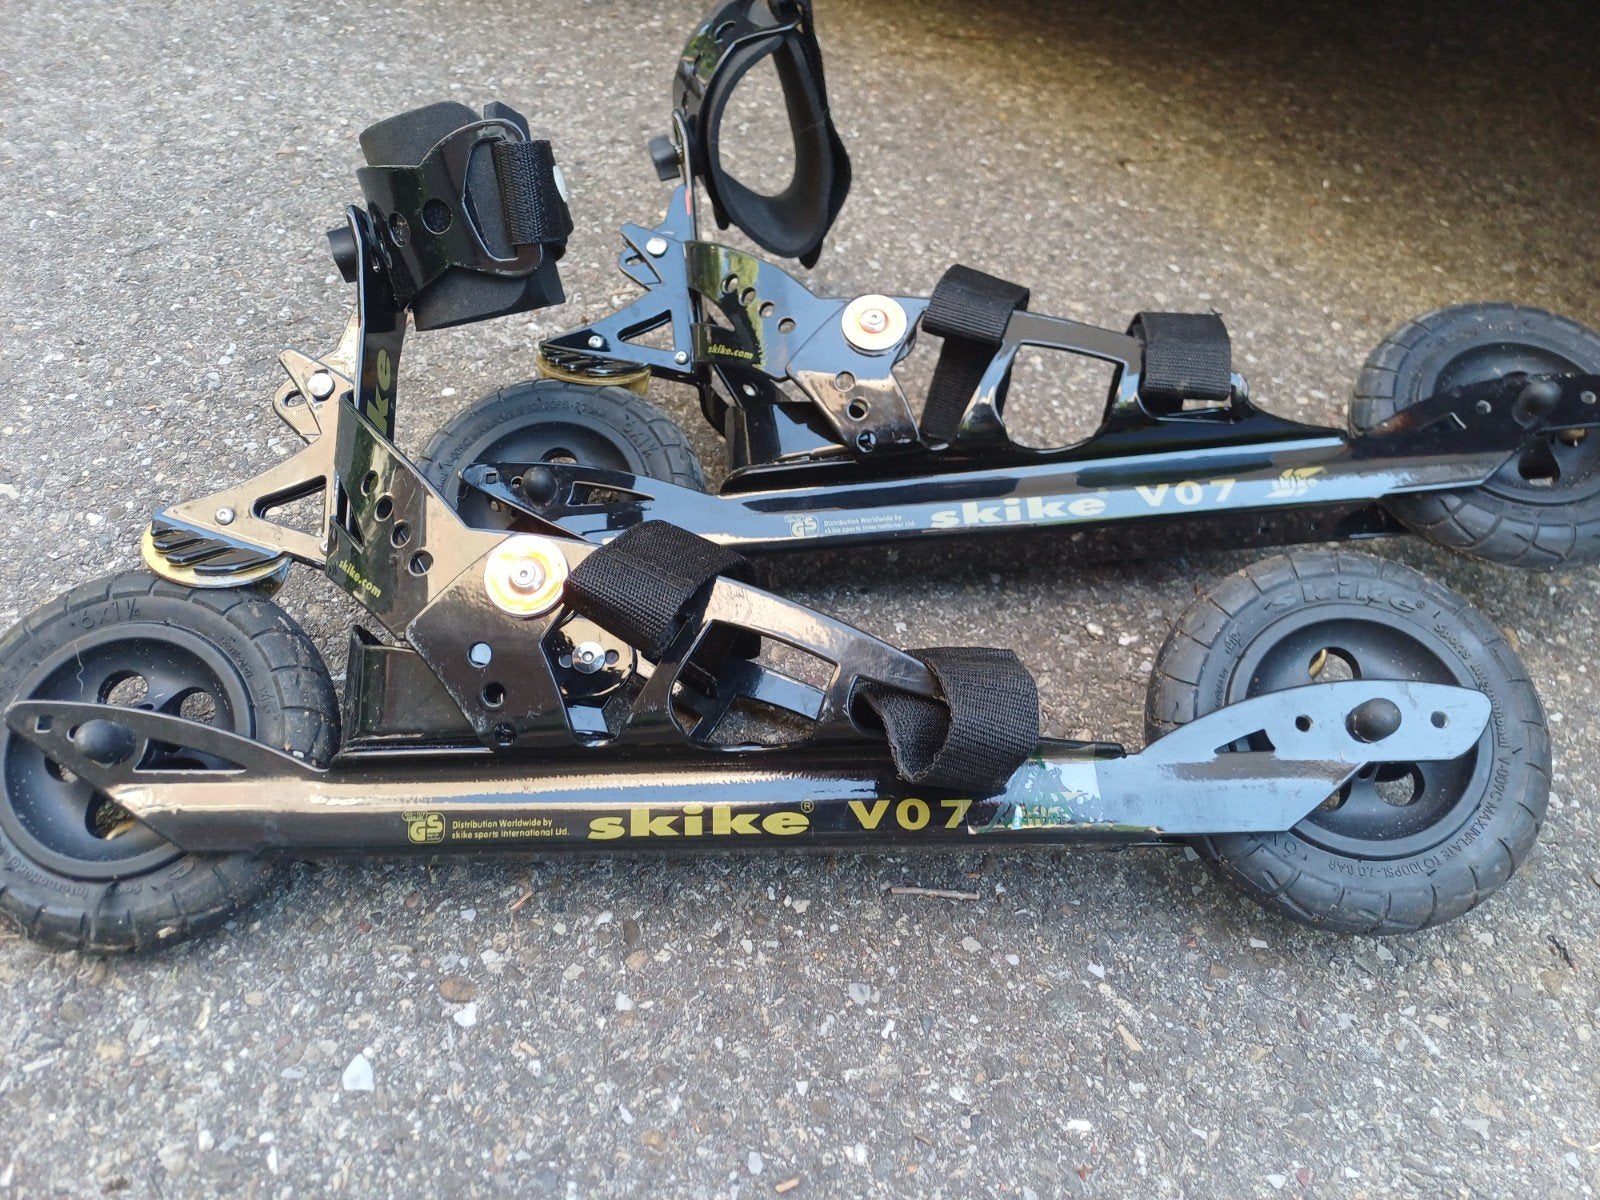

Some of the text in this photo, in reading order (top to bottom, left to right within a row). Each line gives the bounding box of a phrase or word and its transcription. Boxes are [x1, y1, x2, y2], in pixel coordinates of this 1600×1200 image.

[707, 344, 753, 360] skike.com
[824, 517, 860, 527] Distribution
[860, 515, 893, 525] Worldwide
[337, 559, 382, 599] skike.com
[452, 817, 553, 830] Distribution Worldwide by
[452, 830, 473, 840] skike
[474, 830, 499, 840] sports
[501, 828, 553, 839] International
[555, 827, 570, 837] Ltd.
